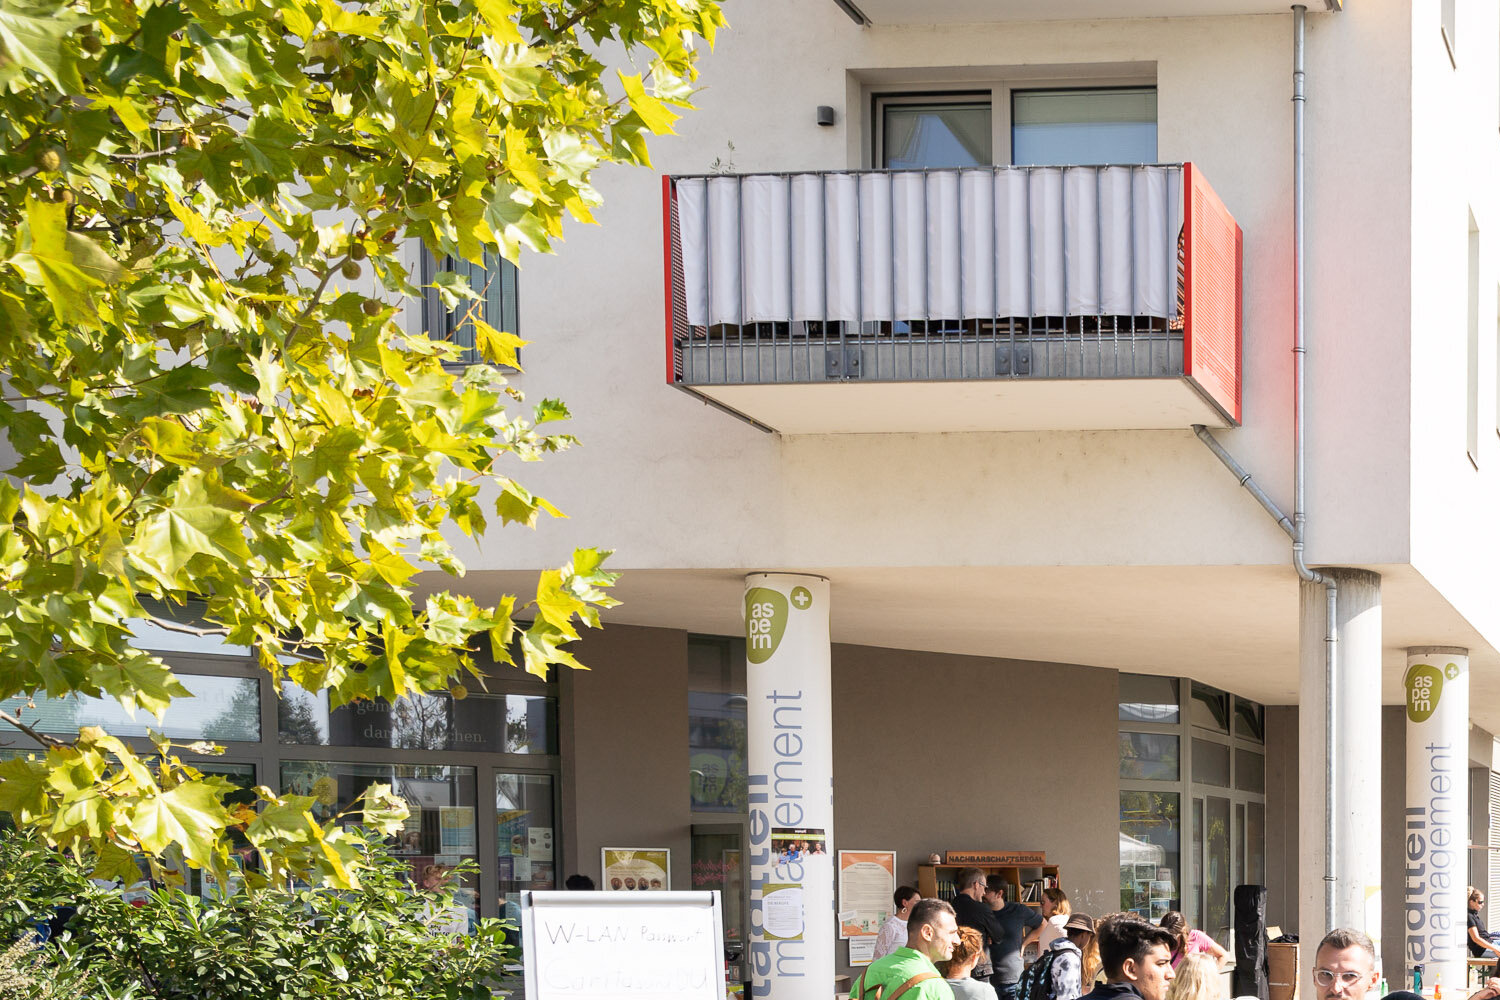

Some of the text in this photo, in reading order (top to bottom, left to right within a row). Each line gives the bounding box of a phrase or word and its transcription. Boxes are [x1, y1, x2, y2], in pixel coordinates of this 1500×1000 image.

[752, 602, 774, 618] as
[749, 619, 772, 639] pe
[752, 633, 772, 649] rn
[1414, 675, 1433, 688] as
[1412, 688, 1430, 703] pe
[1414, 700, 1431, 712] rn
[1425, 742, 1455, 962] management
[544, 920, 629, 944] W-LAN
